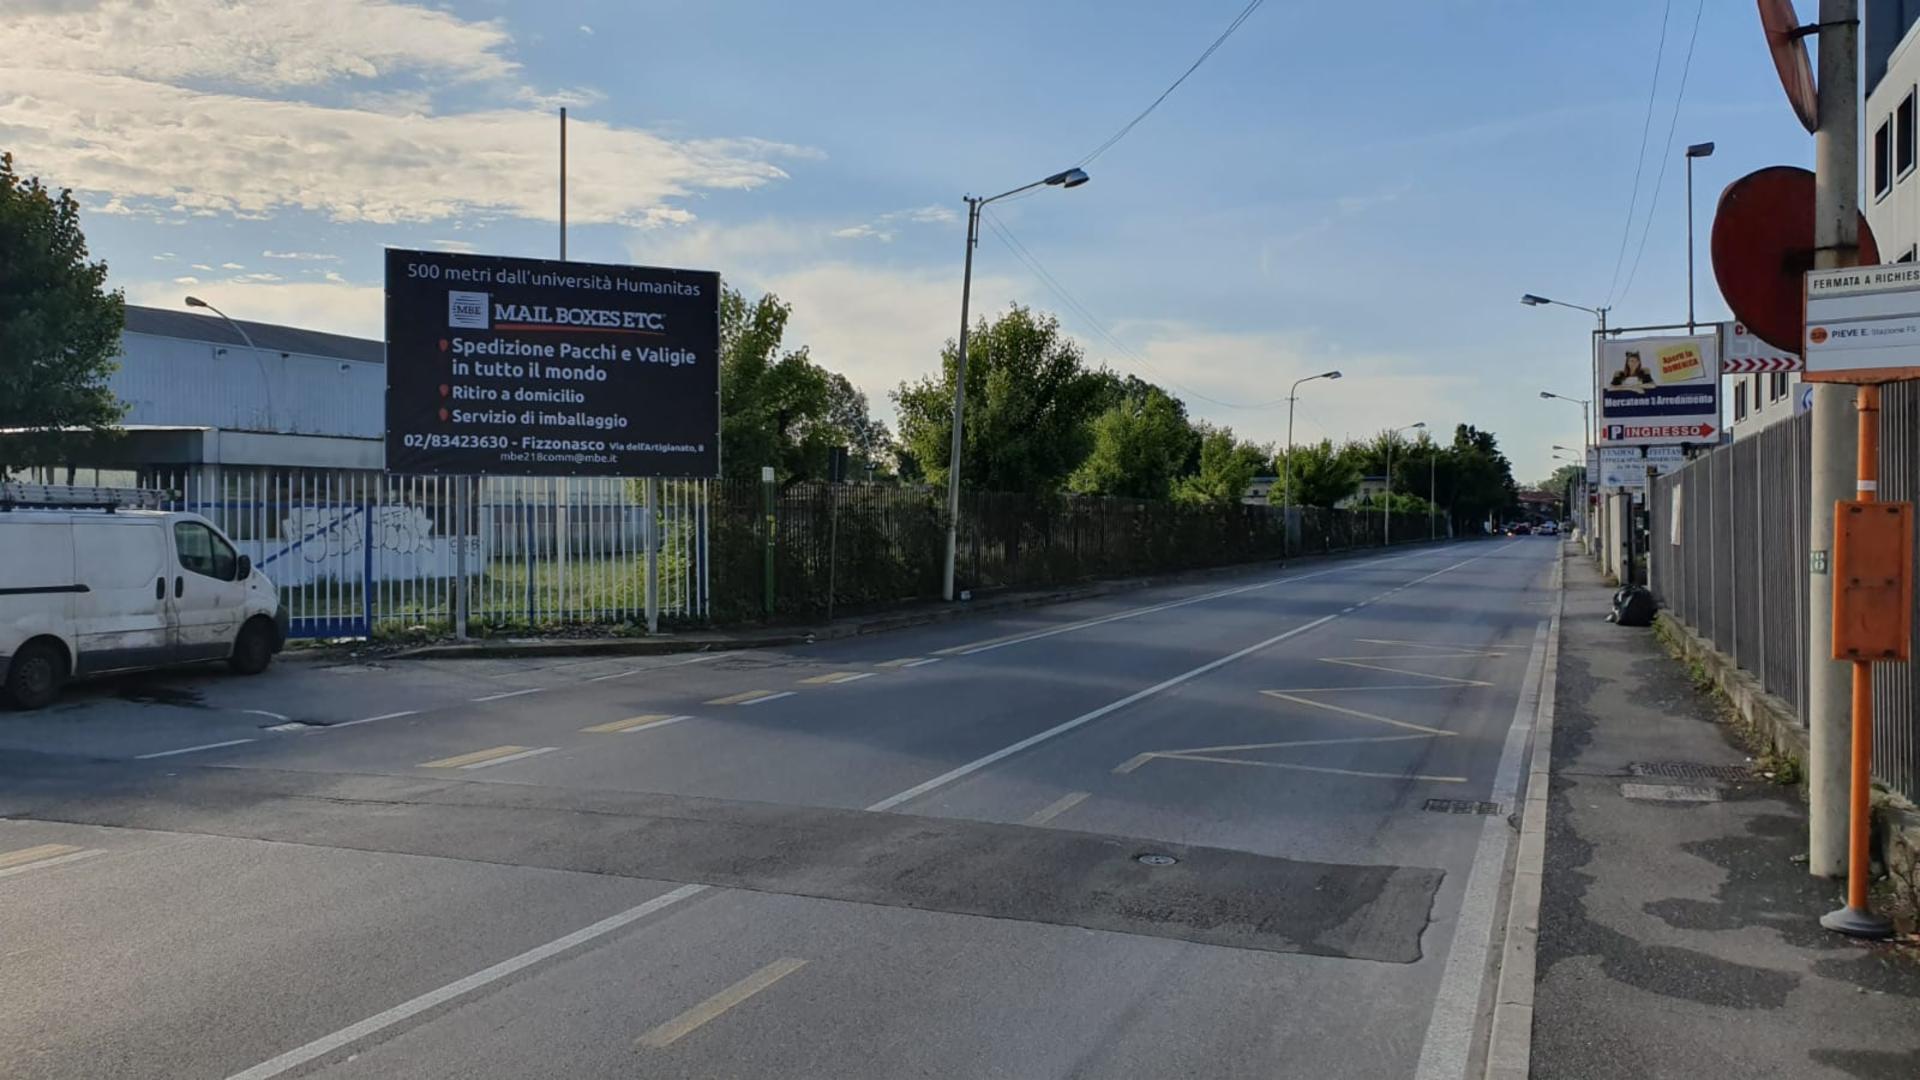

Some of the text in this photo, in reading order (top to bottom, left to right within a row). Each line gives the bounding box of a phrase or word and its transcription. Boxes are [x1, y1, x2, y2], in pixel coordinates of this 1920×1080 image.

[407, 264, 440, 279] 500
[445, 267, 491, 282] metri
[617, 278, 700, 296] Humanitas
[1814, 277, 1860, 289] FERMATA
[455, 305, 481, 315] MBE
[494, 304, 552, 323] MAIL
[556, 307, 621, 327] BOXES
[452, 338, 696, 367] Spedizione Pacchi e Valigie
[452, 360, 607, 381] in tutto il mondo
[452, 386, 584, 403] Ritiro a domicilio
[452, 409, 627, 430] Servizio di imballaggio
[1625, 426, 1700, 438] INGRESSO
[404, 434, 508, 450] 02/83423630
[522, 436, 605, 451] Fizzonasco
[501, 451, 618, 464] mbe218comm@mbe.it
